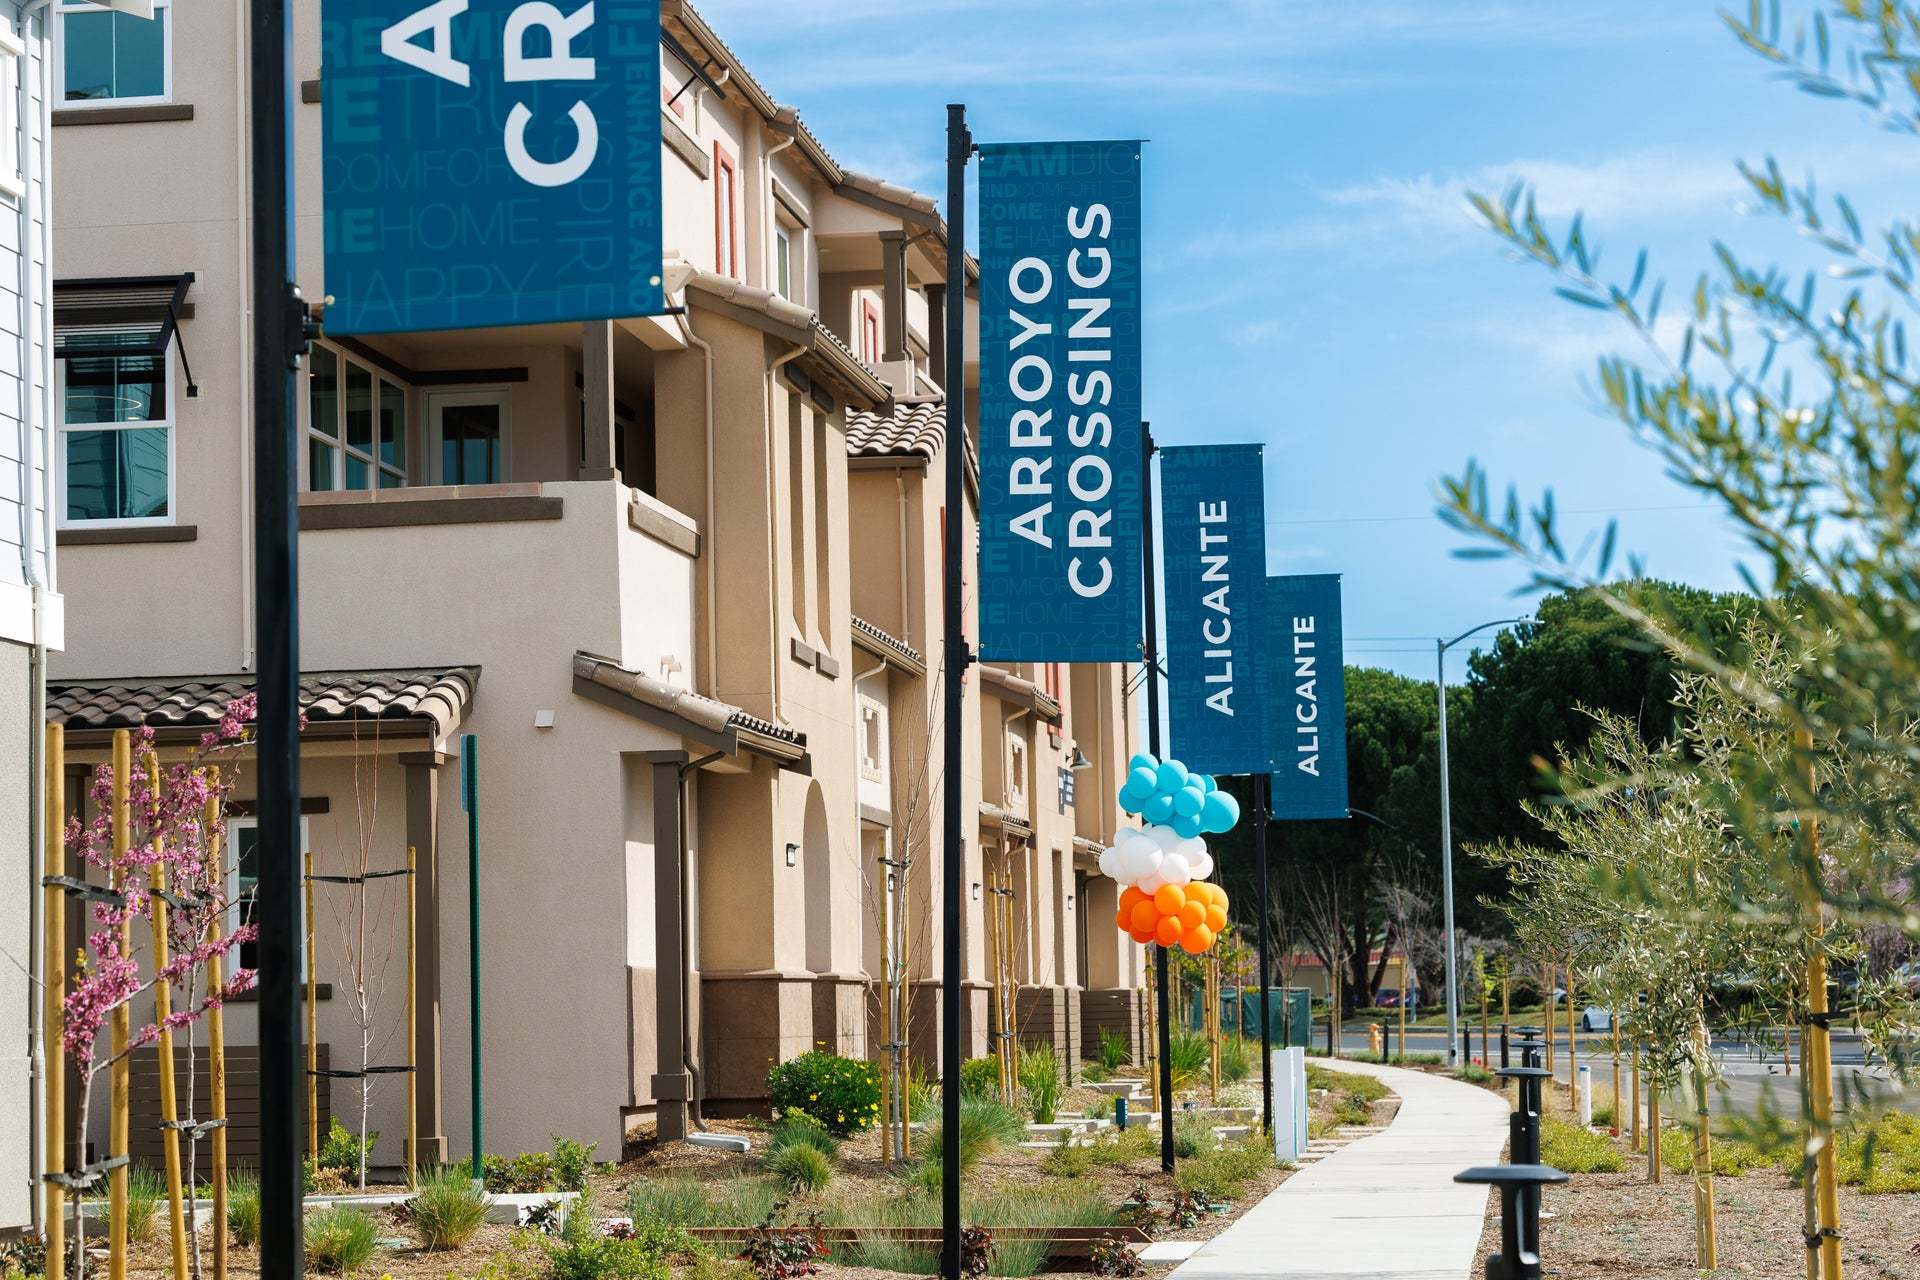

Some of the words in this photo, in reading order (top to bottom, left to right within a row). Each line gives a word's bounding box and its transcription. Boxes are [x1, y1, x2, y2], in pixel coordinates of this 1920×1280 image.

[322, 144, 542, 194] COMFOR
[501, 0, 597, 187] CR
[625, 62, 654, 230] ENHANCE
[381, 198, 541, 252] HOME
[552, 66, 615, 317] NSPIRE
[628, 236, 655, 312] AND
[1112, 239, 1136, 309] LIVE
[1009, 257, 1053, 549] ARROYO
[1067, 203, 1112, 597] CROSSINGS
[1118, 470, 1139, 537] FIND
[1199, 501, 1234, 717] ALICANTE
[1293, 616, 1319, 777] ALICANTE
